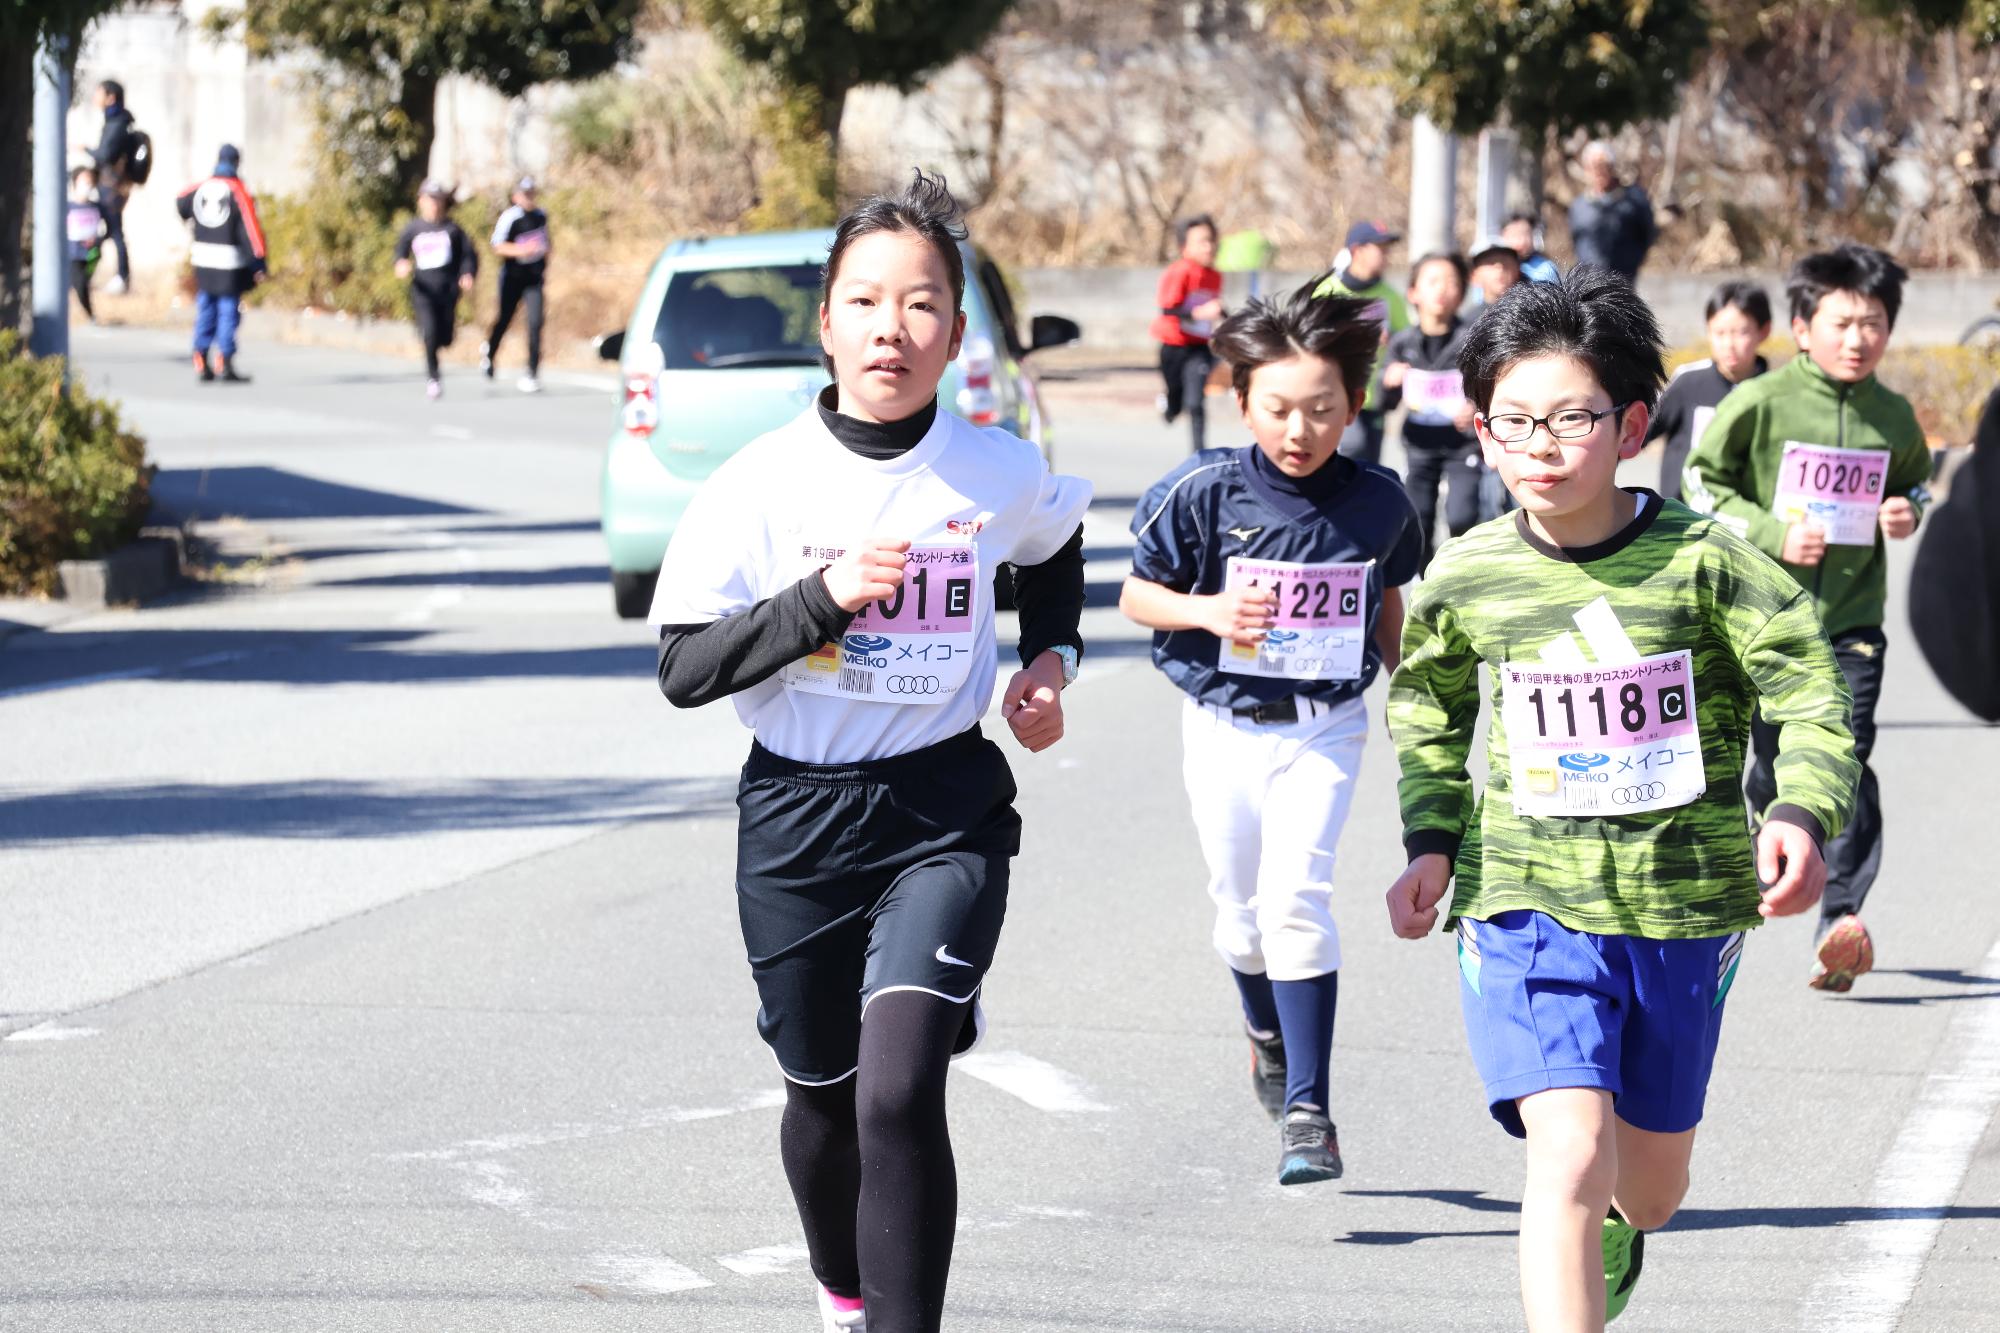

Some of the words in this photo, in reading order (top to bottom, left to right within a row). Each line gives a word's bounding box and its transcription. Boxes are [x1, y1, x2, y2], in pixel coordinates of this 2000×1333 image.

[1800, 461, 1862, 494] 1020
[950, 586, 965, 611] E
[1342, 592, 1356, 613] C
[843, 653, 887, 668] MEIKO
[896, 643, 968, 661] メイコー
[1511, 659, 1682, 685] 第19回甲斐梅の里クロスカントリー大会
[1529, 682, 1647, 737] 1118
[1663, 692, 1682, 717] C
[1563, 772, 1609, 783] MEIKO
[1617, 749, 1695, 774] メイコー
